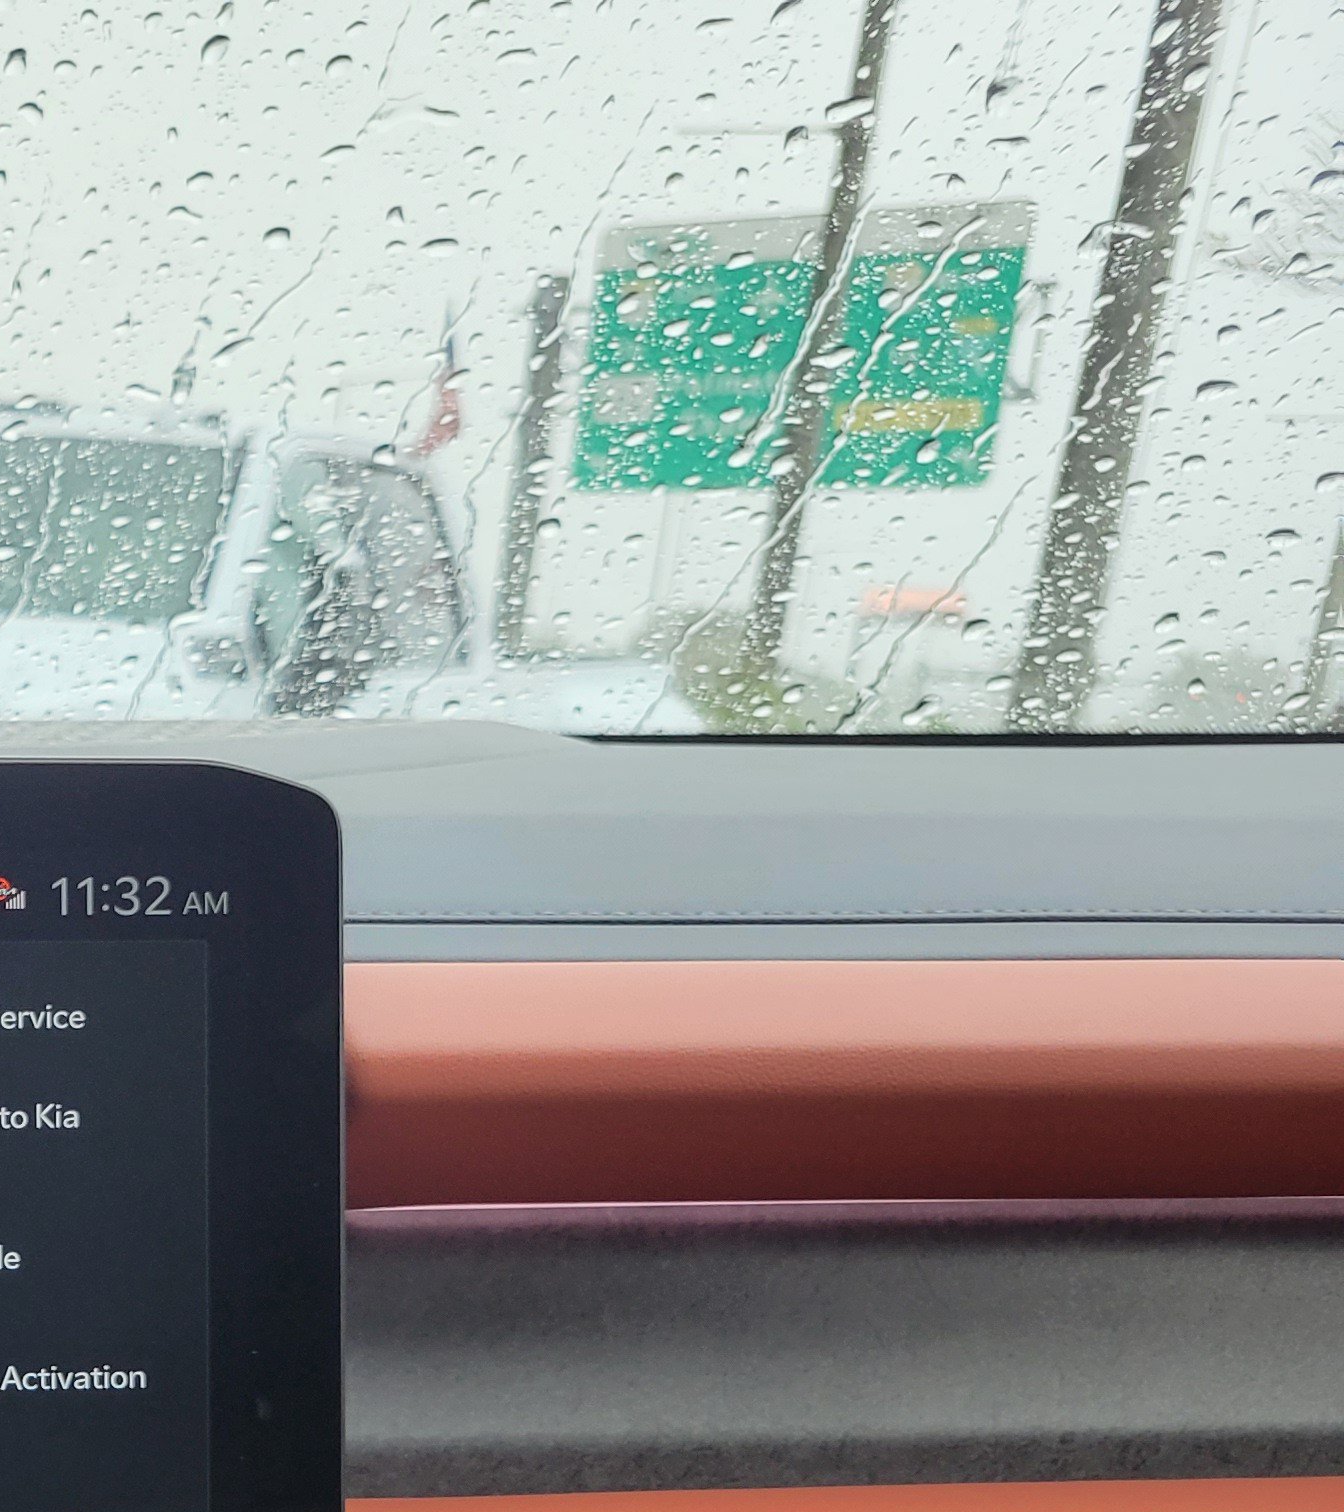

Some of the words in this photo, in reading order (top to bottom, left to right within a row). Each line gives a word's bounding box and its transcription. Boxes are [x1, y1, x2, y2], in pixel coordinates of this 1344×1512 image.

[51, 875, 173, 916] 11:32
[182, 891, 229, 915] AM
[35, 1103, 80, 1129] Kia
[0, 1364, 147, 1391] Activation
